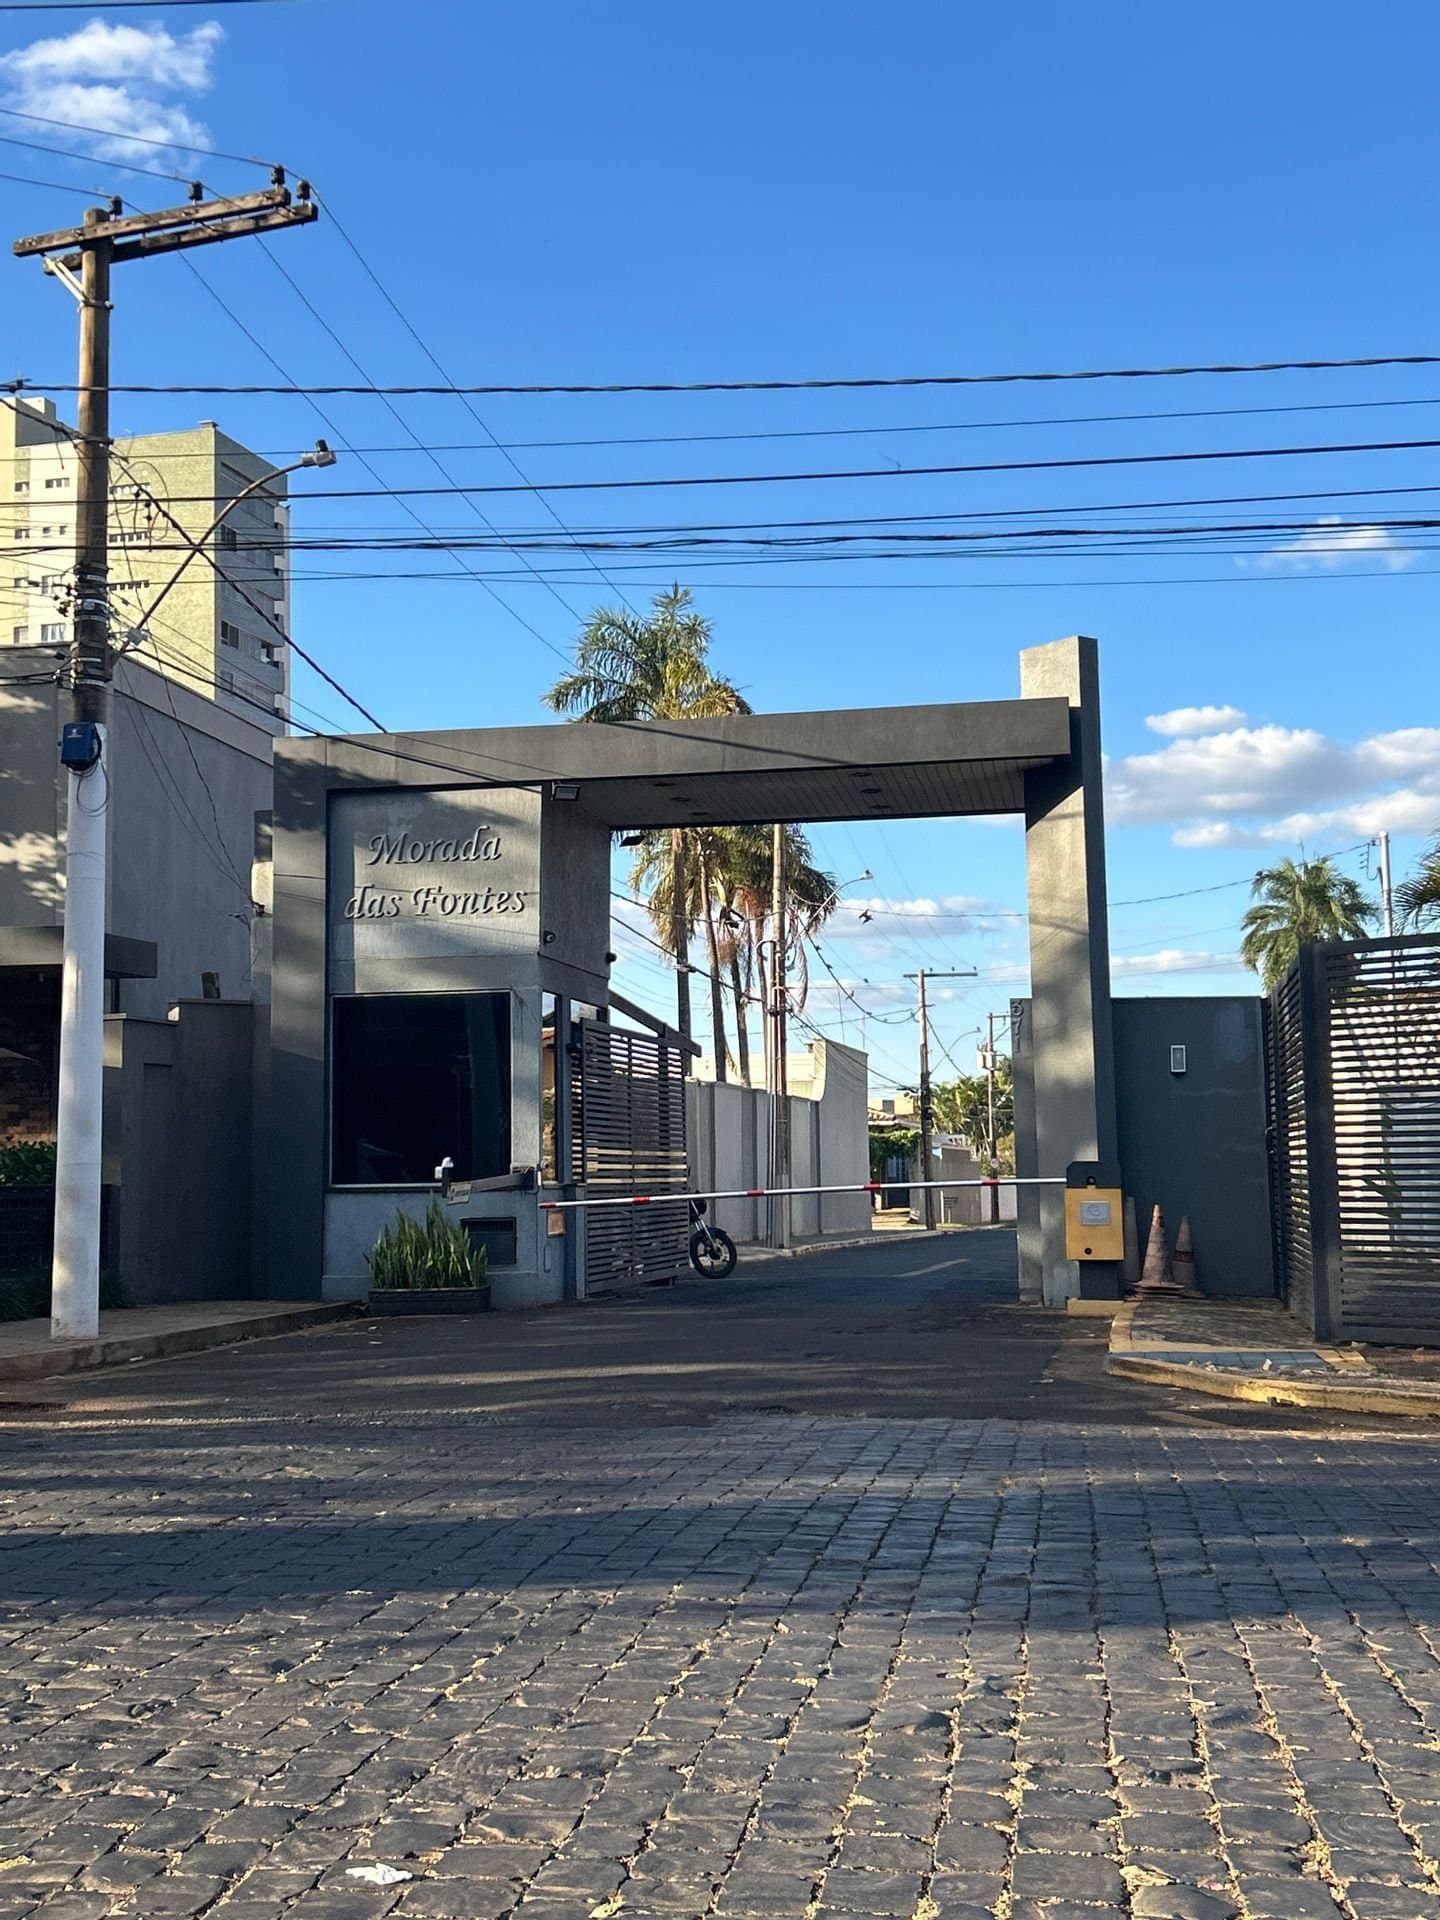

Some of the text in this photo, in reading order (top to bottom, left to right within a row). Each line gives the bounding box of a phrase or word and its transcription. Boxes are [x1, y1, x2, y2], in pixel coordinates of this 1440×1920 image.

[367, 825, 502, 865] Morada
[344, 884, 528, 919] das Fontes
